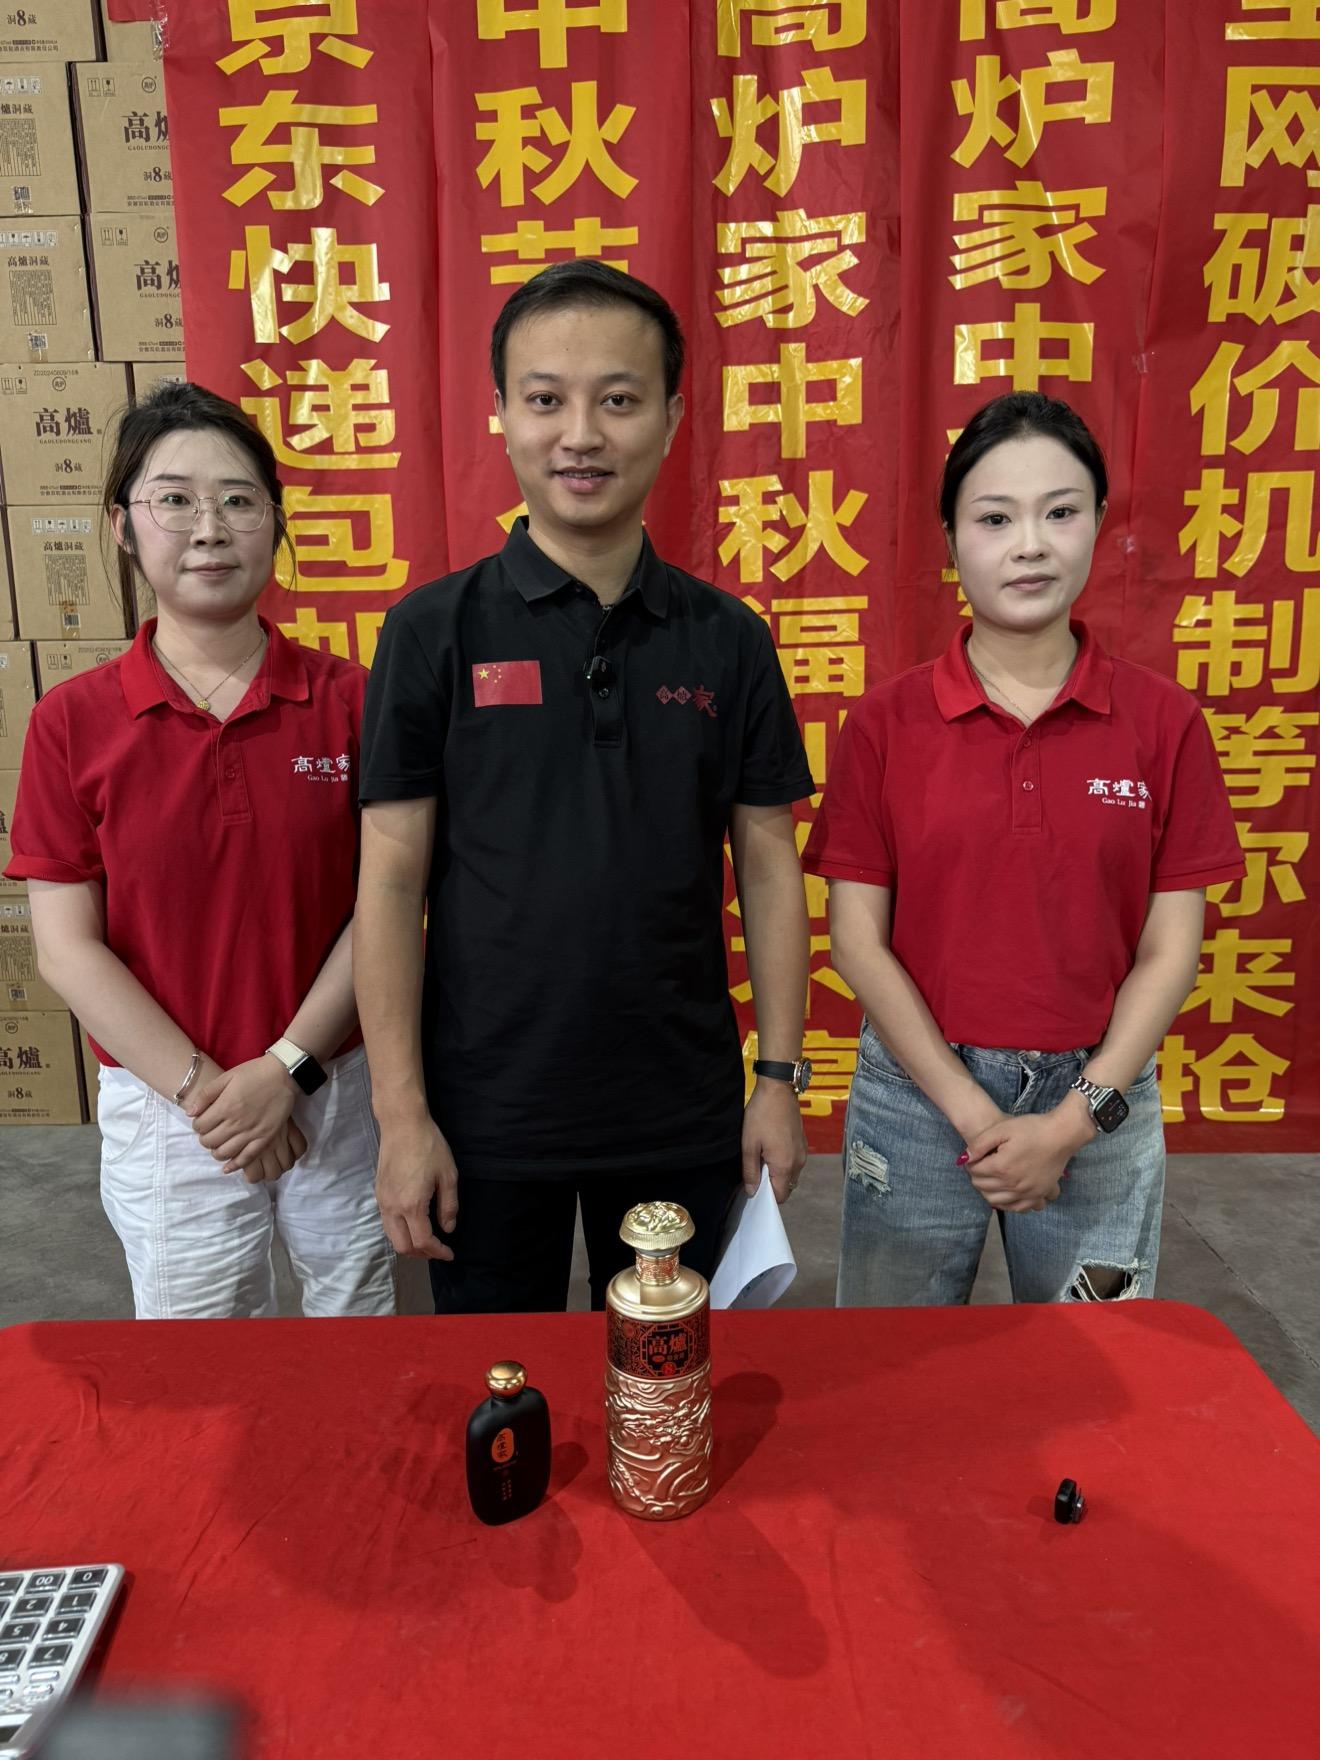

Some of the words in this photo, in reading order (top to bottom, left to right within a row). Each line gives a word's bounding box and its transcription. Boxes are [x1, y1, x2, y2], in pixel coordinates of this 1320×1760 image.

[33, 407, 93, 437] 高爐
[35, 1576, 53, 1585] 00
[83, 1572, 92, 1581] 0
[26, 1600, 37, 1609] 2
[72, 1596, 79, 1606] 1
[12, 1625, 23, 1636] 5
[58, 1622, 68, 1632] 4
[44, 1648, 55, 1659] 7
